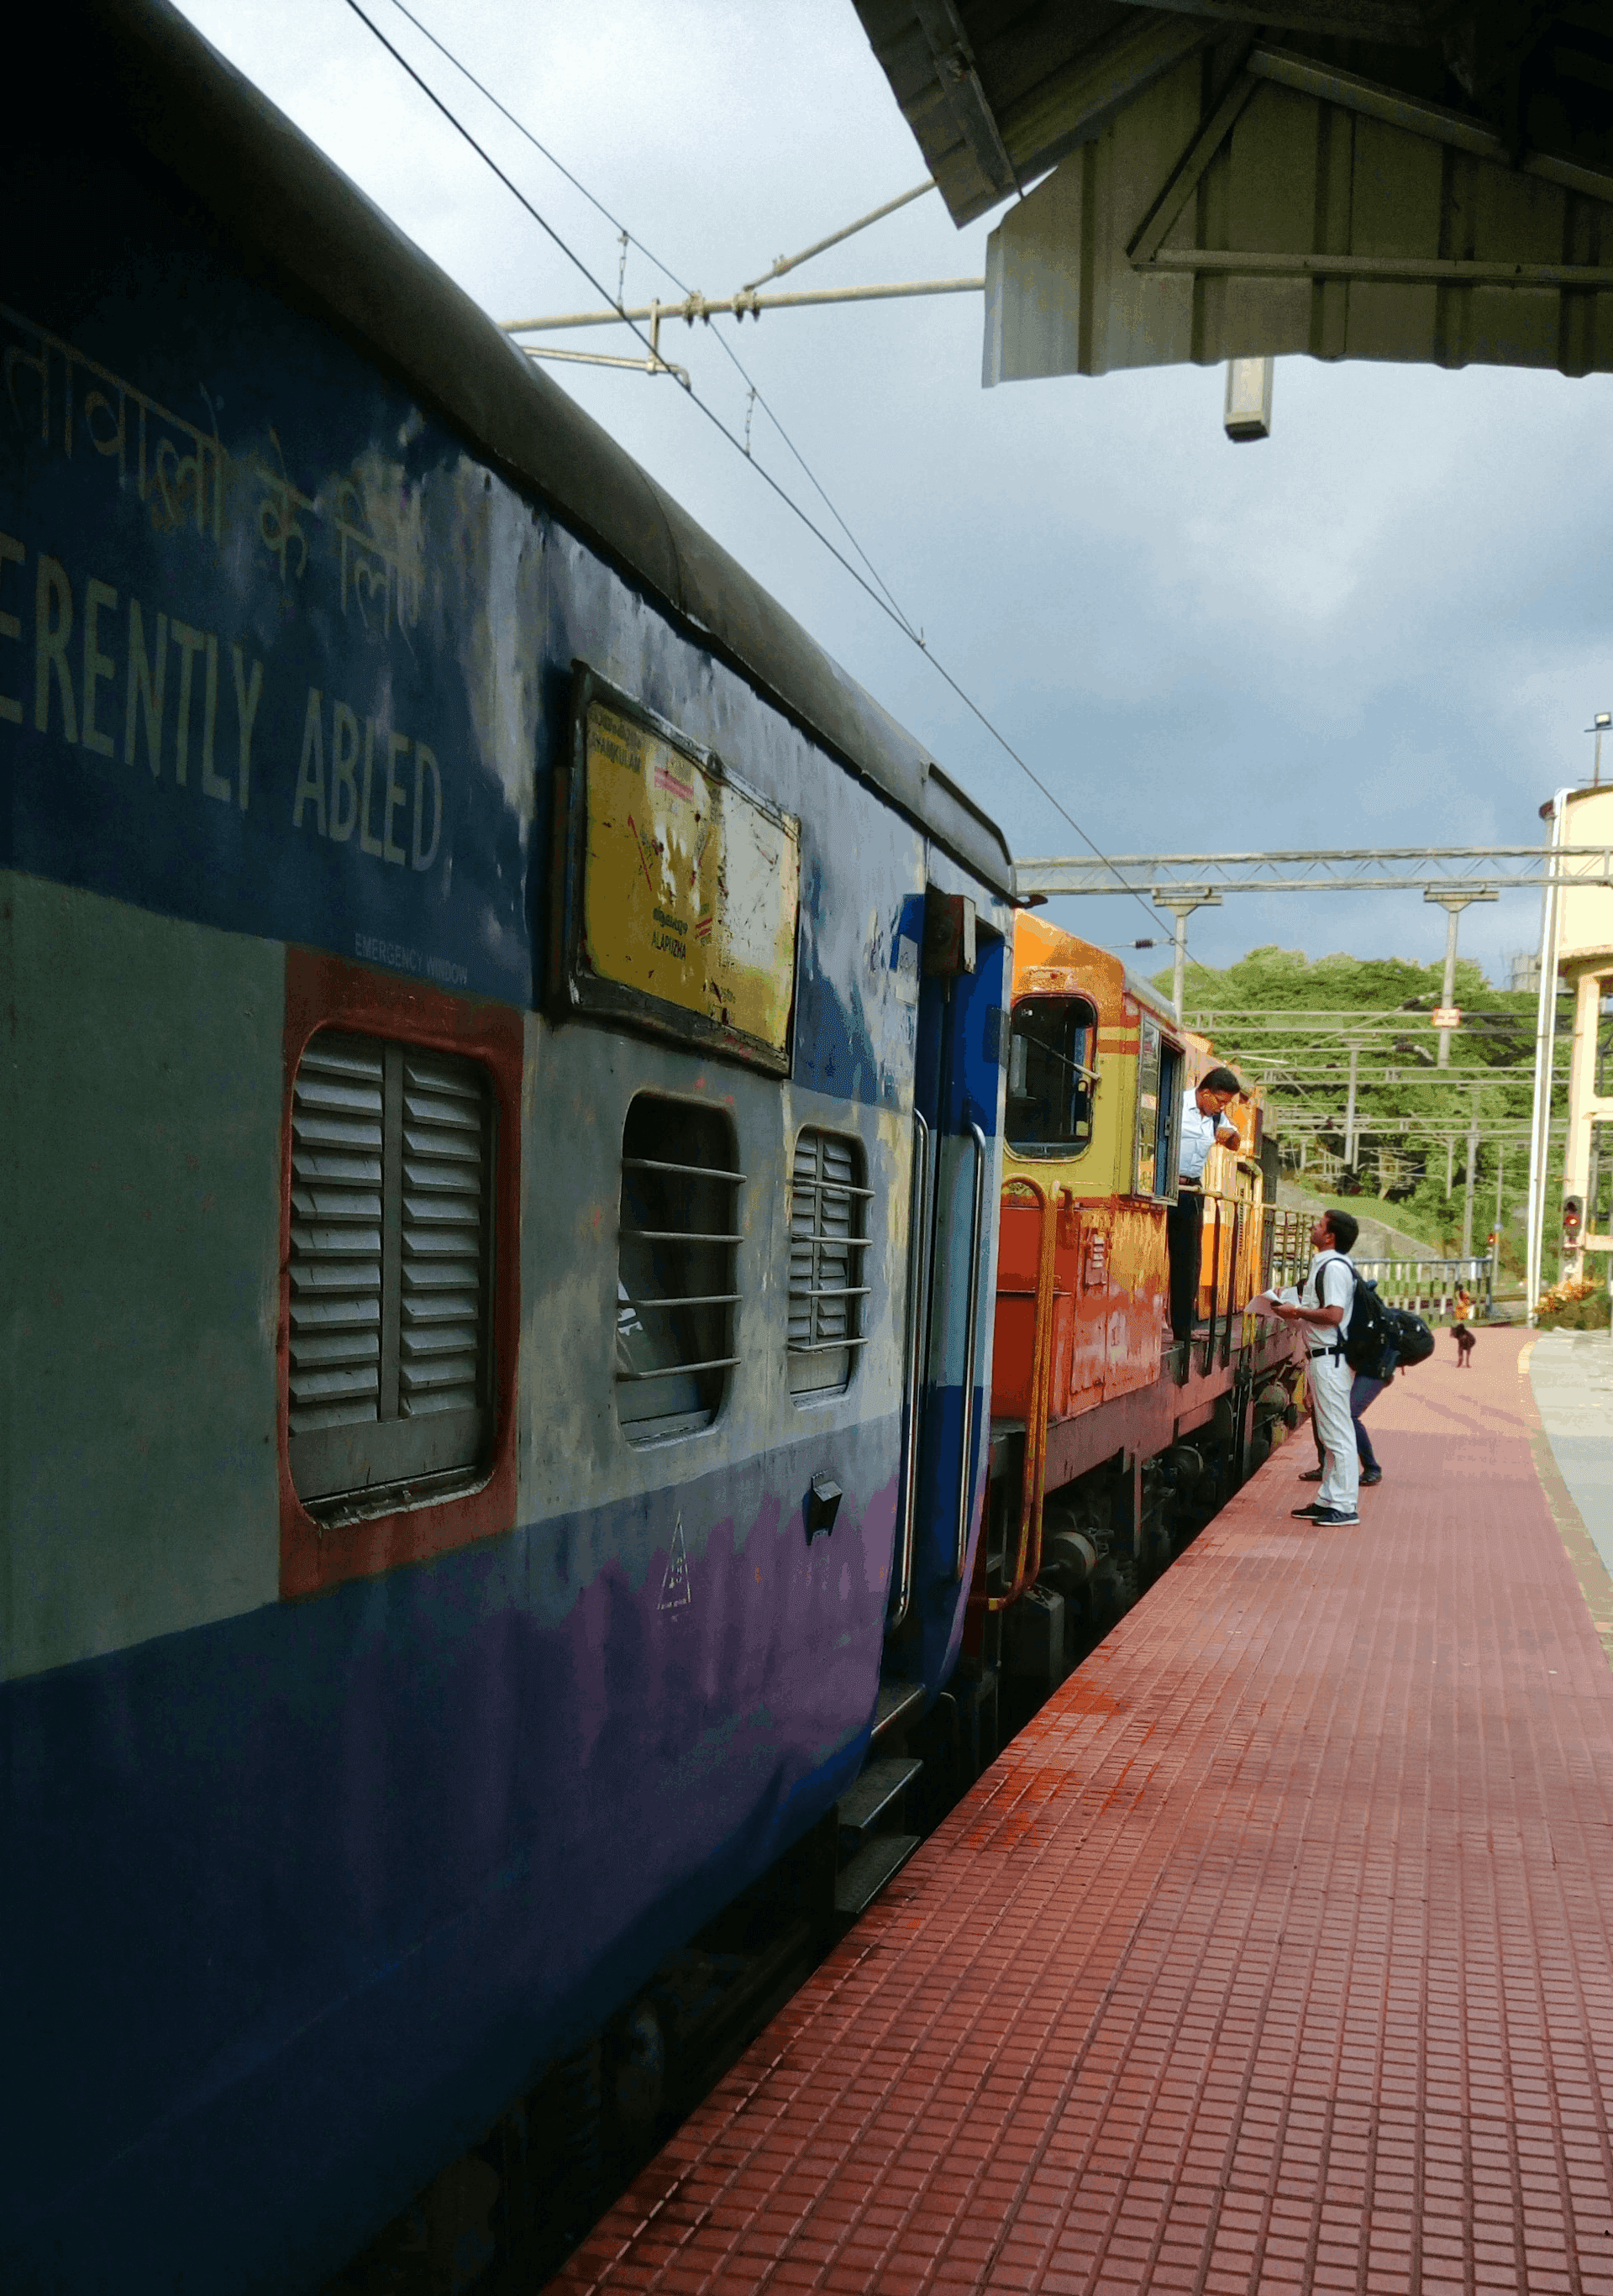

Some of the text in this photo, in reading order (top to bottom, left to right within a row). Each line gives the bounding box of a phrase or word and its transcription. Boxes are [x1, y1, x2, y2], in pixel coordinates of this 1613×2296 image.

[250, 423, 314, 588] के
[292, 687, 443, 871] ABLED
[355, 932, 468, 986] EMERGENCY WINDOW
